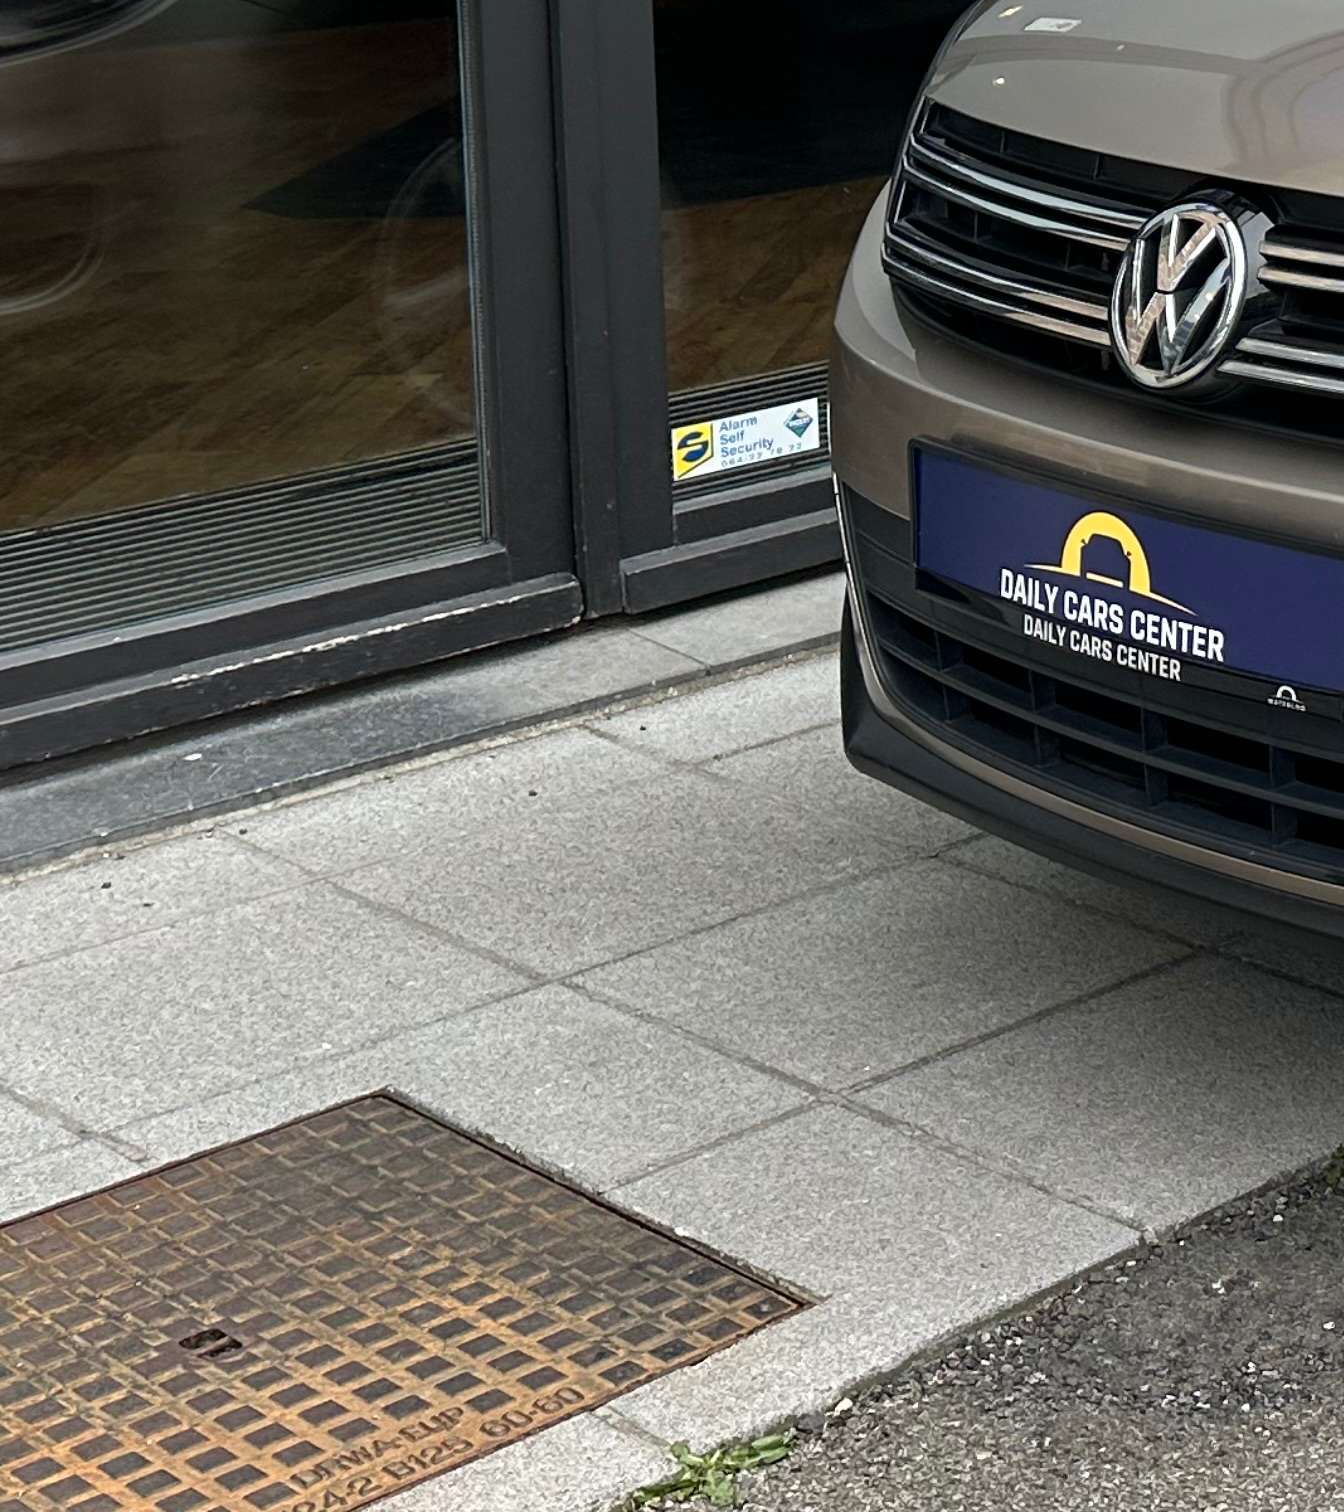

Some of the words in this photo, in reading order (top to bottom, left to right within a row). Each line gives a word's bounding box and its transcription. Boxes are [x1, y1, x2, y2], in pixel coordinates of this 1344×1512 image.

[719, 415, 758, 433] Alarm
[720, 431, 745, 446] Self
[720, 438, 774, 459] Security
[1000, 568, 1059, 615] DAILY
[1063, 590, 1124, 635] CARS
[1130, 609, 1225, 663] CENTER
[1023, 614, 1066, 647] DAILY
[1069, 630, 1112, 662] CARS
[1116, 644, 1181, 682] CENTER
